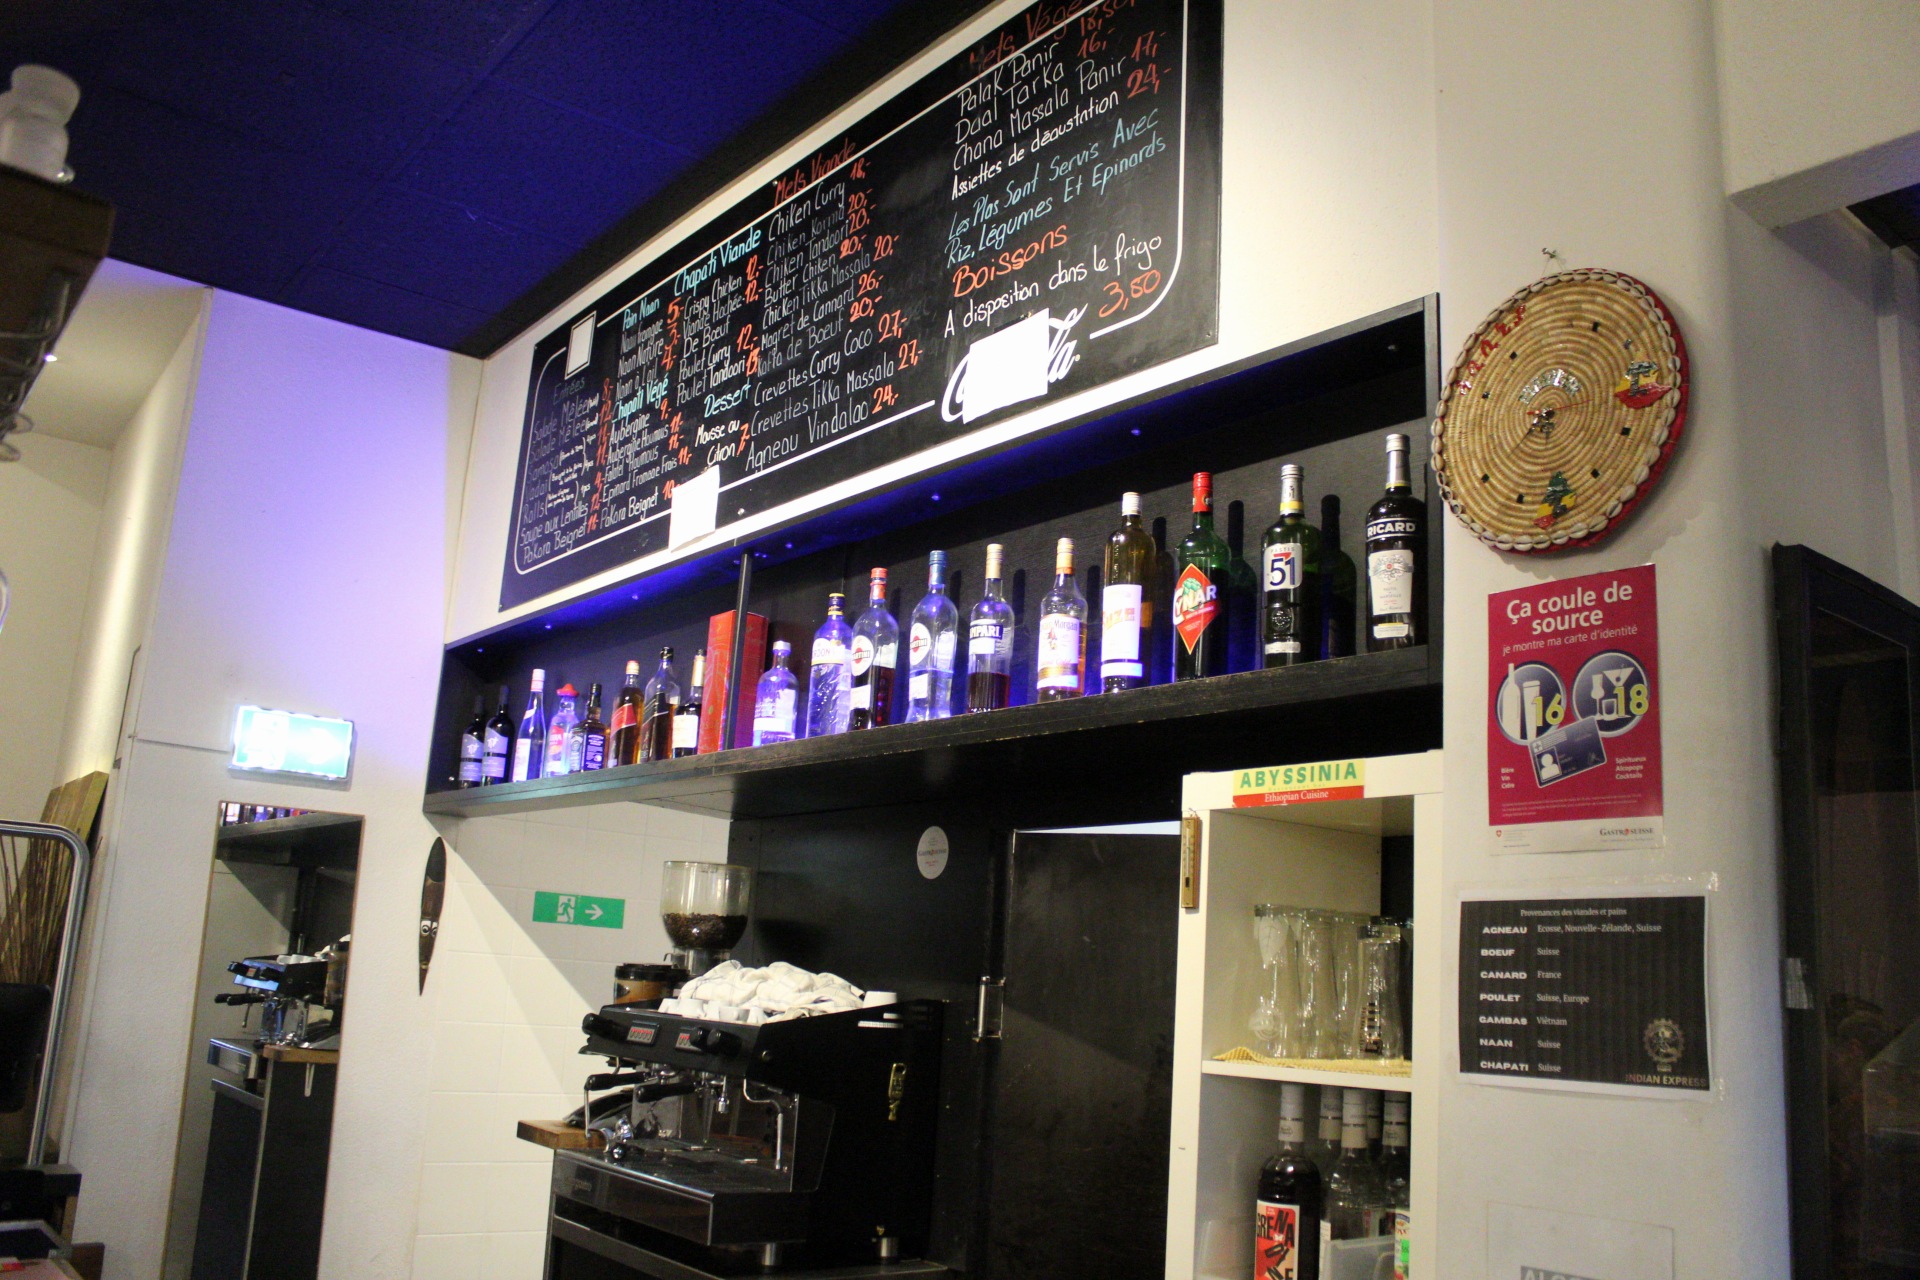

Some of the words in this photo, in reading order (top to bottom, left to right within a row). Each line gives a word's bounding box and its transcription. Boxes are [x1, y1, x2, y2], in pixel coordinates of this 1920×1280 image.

[957, 65, 1003, 116] Palak
[1008, 42, 1059, 84] Panir
[953, 129, 1003, 171] Chana
[1010, 83, 1069, 138] Massala
[1075, 56, 1126, 95] Panir
[955, 96, 998, 145] Daal
[948, 211, 969, 241] Les
[1004, 162, 1039, 208] Sont
[1049, 142, 1099, 182] Servis
[1113, 107, 1159, 149] Avec
[952, 159, 1002, 201] Assiettes
[1008, 142, 1025, 166] de
[815, 181, 845, 210] Curry
[978, 196, 1053, 250] Légumes
[1064, 175, 1083, 203] Et
[1092, 130, 1166, 196] Epinards
[805, 219, 849, 260] Tandoori
[674, 251, 717, 297] Chapati
[719, 226, 762, 267] Viande
[831, 249, 871, 288] Massala
[953, 224, 1068, 297] Boissons
[764, 274, 798, 308] Butter
[944, 309, 955, 338] A
[963, 280, 1039, 327] disposition
[1049, 259, 1088, 290] dans
[1093, 244, 1109, 272] le
[1114, 232, 1162, 276] frigo
[683, 295, 710, 319] Crispy
[761, 313, 795, 353] Magret
[797, 309, 810, 331] de
[813, 279, 854, 322] Cannard
[679, 348, 706, 383] Poulet
[708, 344, 731, 368] Curry
[683, 337, 699, 358] De
[786, 336, 803, 361] de
[754, 367, 808, 407] Crevettes
[809, 350, 841, 378] Curry
[844, 327, 873, 356] Coco
[646, 372, 669, 409] Végé
[677, 369, 707, 406] Poulet
[703, 377, 752, 418] Dessert
[750, 397, 809, 437] Crevettes
[846, 351, 894, 395] Massala
[695, 424, 726, 448] Mousse
[727, 419, 741, 434] au
[707, 442, 736, 466] Citron
[745, 433, 799, 473] Agneau
[628, 486, 659, 520] Beignet
[1367, 521, 1416, 538] RICARD
[1269, 556, 1295, 587] 51
[1506, 599, 1532, 625] Ça
[1538, 586, 1597, 614] coule
[1603, 580, 1633, 604] de
[1532, 608, 1604, 636] source
[1503, 644, 1511, 656] je
[1512, 639, 1545, 653] montre
[1547, 637, 1562, 647] ma
[1564, 632, 1588, 645] carte
[1590, 624, 1638, 641] d'identité
[1533, 693, 1565, 727] 16
[1613, 683, 1649, 717] 18
[1240, 762, 1357, 789] ABYSSINIA
[1264, 791, 1300, 805] Ethiopian
[1300, 790, 1329, 800] Cuisine
[1482, 926, 1528, 935] AGNEAU
[1636, 923, 1662, 933] Suisse
[1480, 949, 1516, 957] BOEUF
[1536, 947, 1560, 956] Suisse
[1480, 971, 1528, 980] CANARD
[1537, 970, 1562, 979] France
[1479, 993, 1521, 1002] POULET
[1563, 994, 1590, 1005] Europe
[1479, 1016, 1528, 1026] GAMBAS
[1479, 1038, 1513, 1048] NAAN
[1537, 1040, 1561, 1049] Suisse
[1480, 1061, 1529, 1072] CHAPATI
[1538, 1063, 1562, 1073] Suisse
[1625, 1073, 1661, 1085] INDIAN
[1662, 1075, 1707, 1088] EXPRESS
